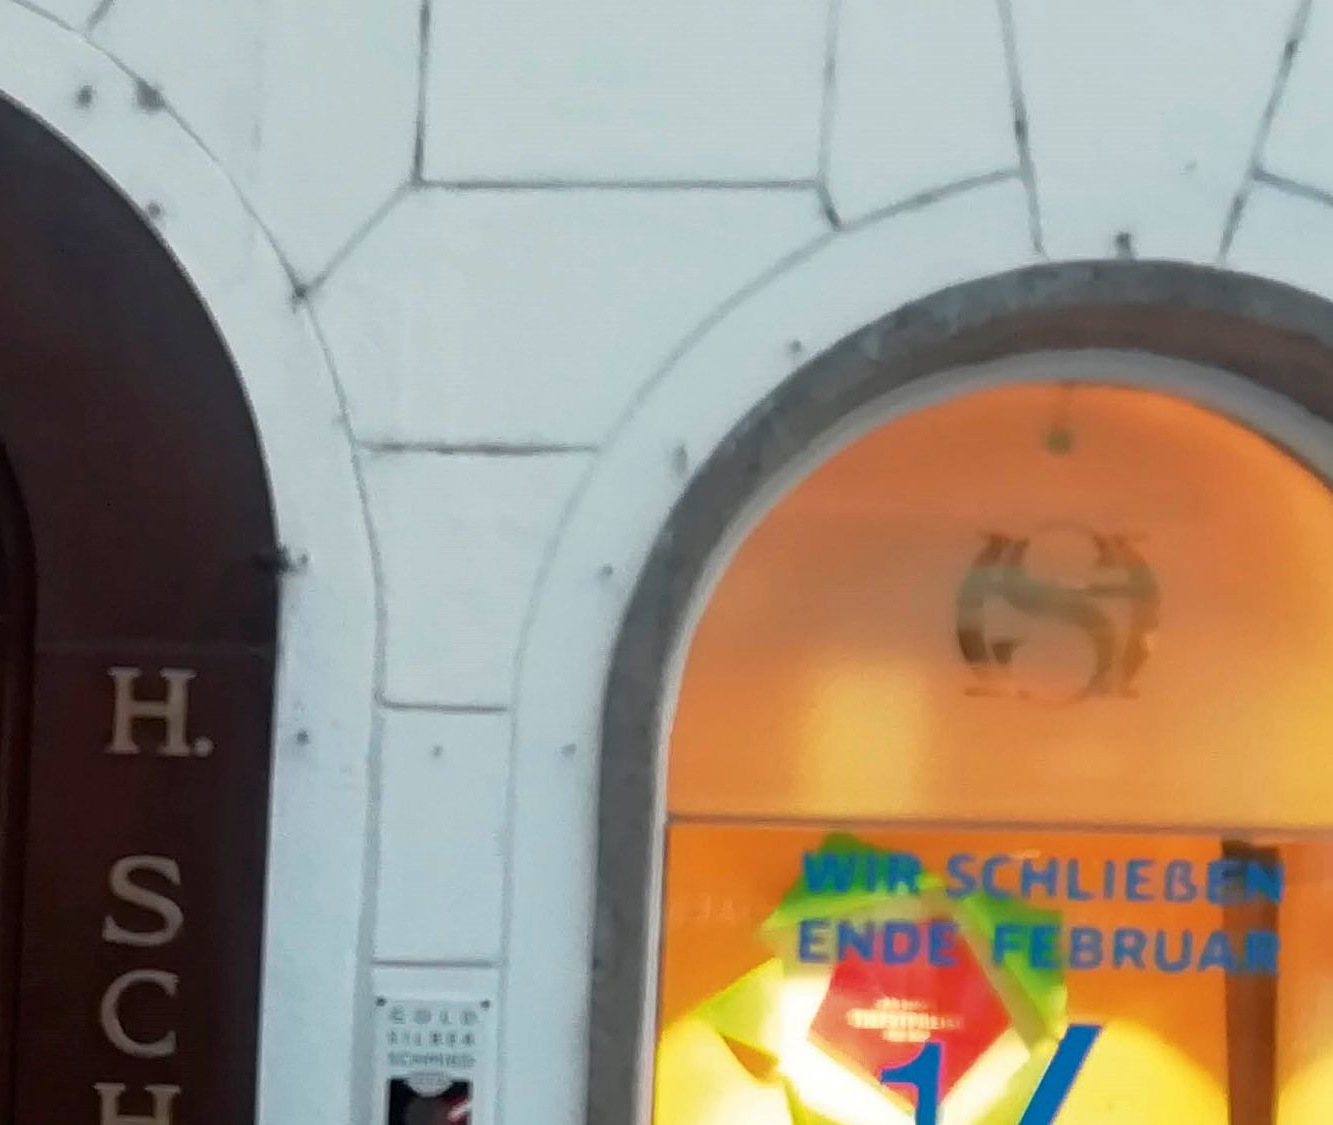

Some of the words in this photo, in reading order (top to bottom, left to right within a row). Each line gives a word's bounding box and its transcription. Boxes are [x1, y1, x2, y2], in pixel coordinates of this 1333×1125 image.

[104, 666, 213, 757] H.
[802, 850, 923, 895] WIR
[798, 918, 959, 968] ENDE
[992, 923, 1279, 975] FEBRUAR
